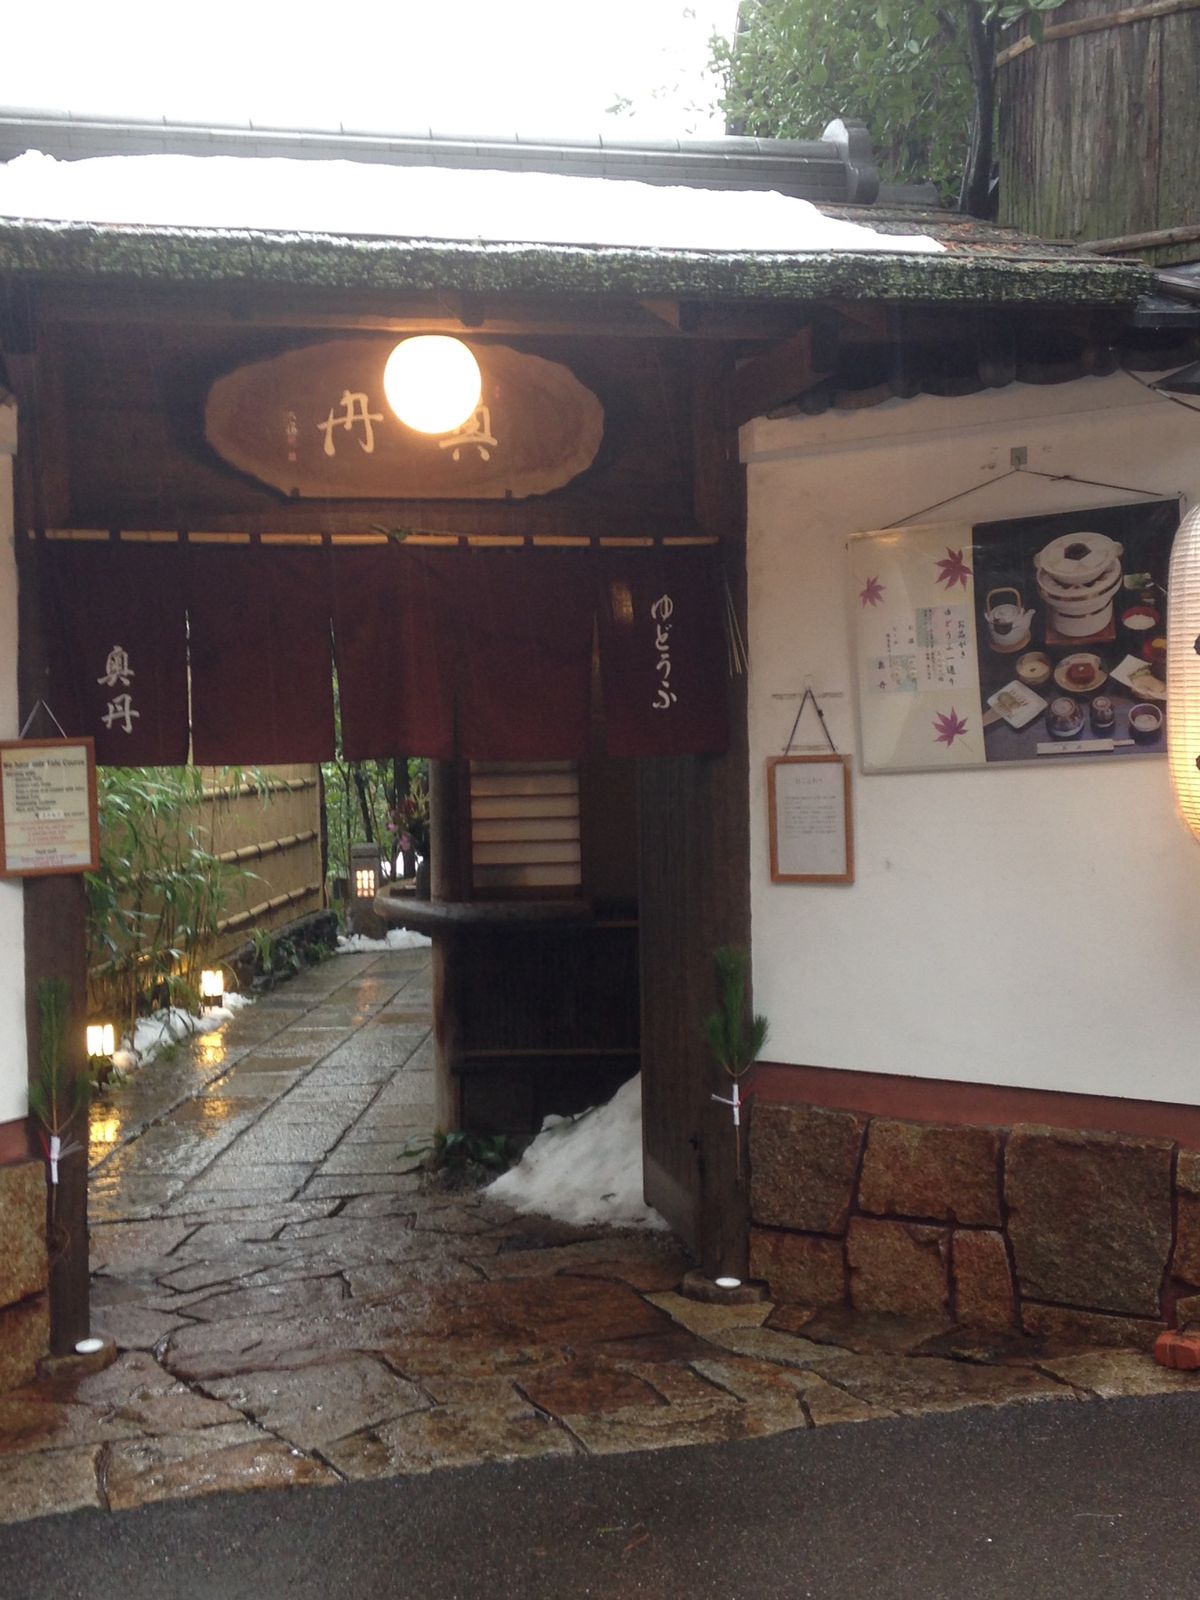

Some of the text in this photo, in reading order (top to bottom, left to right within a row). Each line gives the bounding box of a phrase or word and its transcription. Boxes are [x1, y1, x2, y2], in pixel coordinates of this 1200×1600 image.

[97, 644, 140, 734] 奥丹
[651, 594, 678, 709] ゆどうふ
